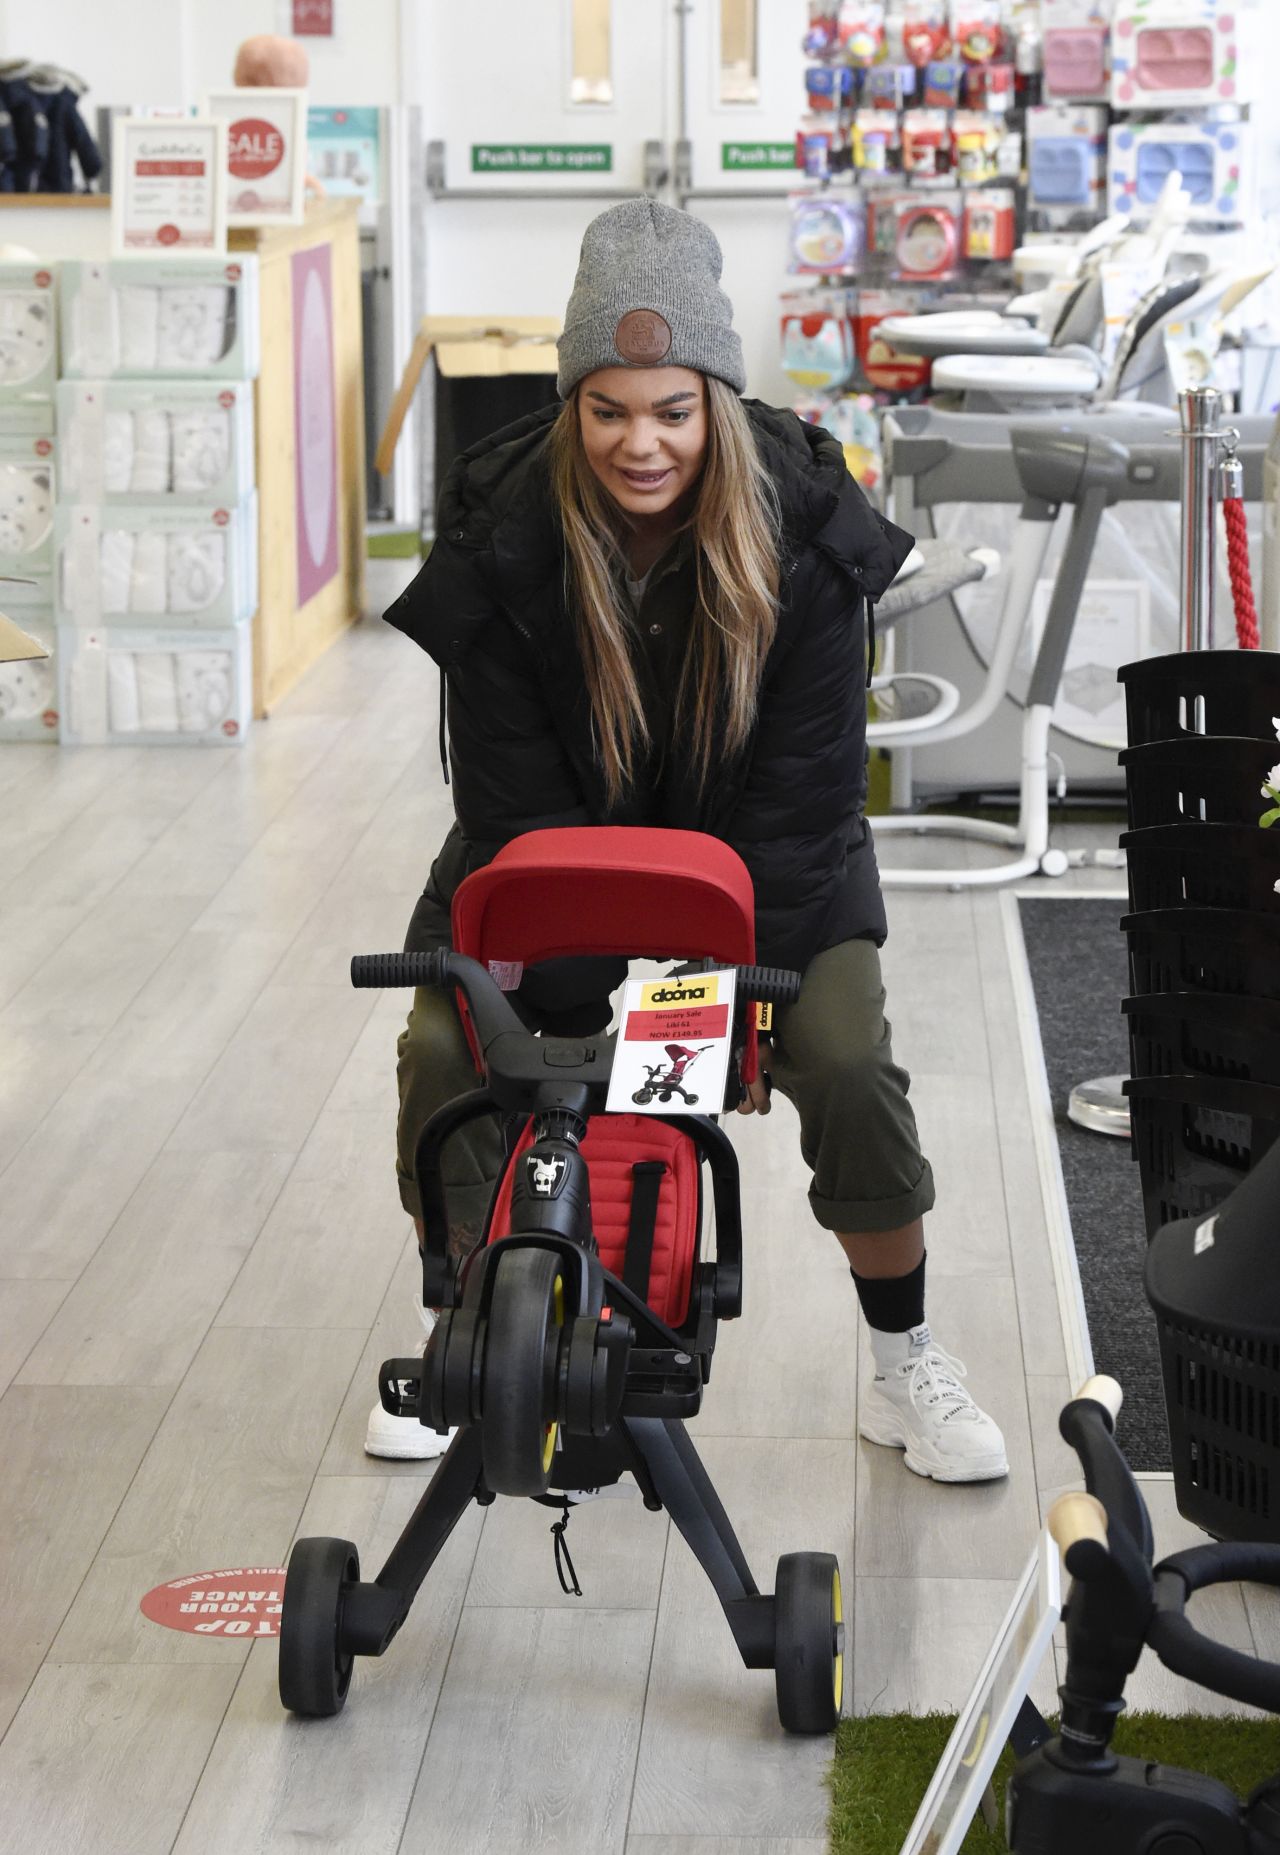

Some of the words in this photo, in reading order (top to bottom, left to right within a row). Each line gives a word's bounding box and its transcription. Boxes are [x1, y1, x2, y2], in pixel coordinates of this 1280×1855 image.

[478, 148, 517, 165] Push
[519, 149, 543, 165] bar
[547, 150, 564, 165] to
[566, 152, 605, 169] open
[728, 147, 765, 163] Push
[651, 987, 706, 1003] doona
[655, 1012, 684, 1021] January
[686, 1010, 702, 1018] Sale
[649, 1031, 671, 1039] NOW
[190, 1591, 281, 1602] TANCE
[179, 1602, 257, 1613] YOUR
[194, 1619, 281, 1634] TOP
